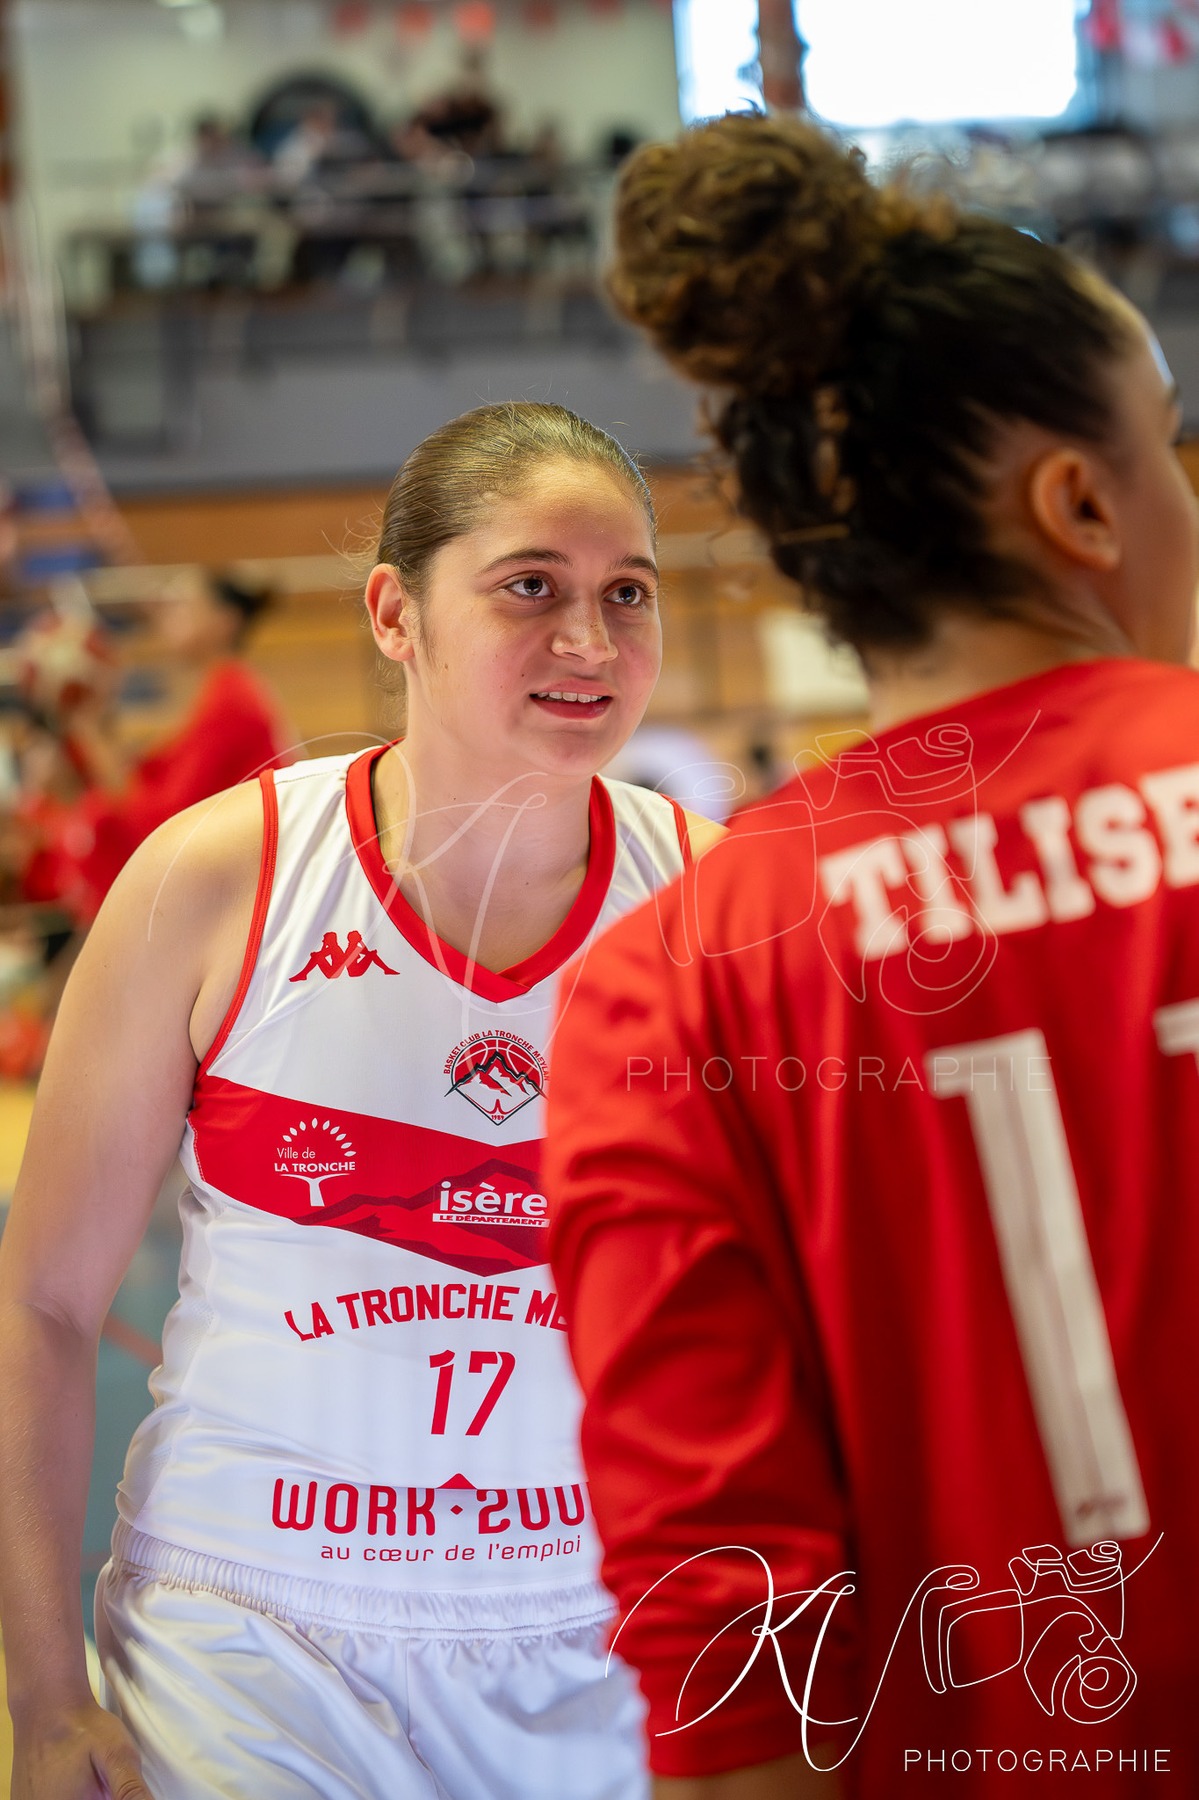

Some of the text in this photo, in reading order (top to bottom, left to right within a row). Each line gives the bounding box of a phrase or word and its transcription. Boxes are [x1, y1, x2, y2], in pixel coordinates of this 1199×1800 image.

[443, 1046, 461, 1074] BASKET
[460, 1033, 481, 1047] CLUB
[495, 1030, 534, 1051] TRONCHE
[532, 1051, 549, 1081] MEYLAN
[274, 1162, 355, 1172] LA TRONCHE
[277, 1147, 315, 1158] Ville de
[440, 1181, 547, 1215] isère
[455, 1215, 544, 1225] DÉPARTEMENT
[284, 1302, 334, 1341] LA
[336, 1284, 520, 1329] TRONCHE
[429, 1350, 515, 1436] 17
[272, 1478, 435, 1536] WORK
[321, 1545, 350, 1559] au
[363, 1547, 434, 1561] cœur
[445, 1544, 475, 1561] de
